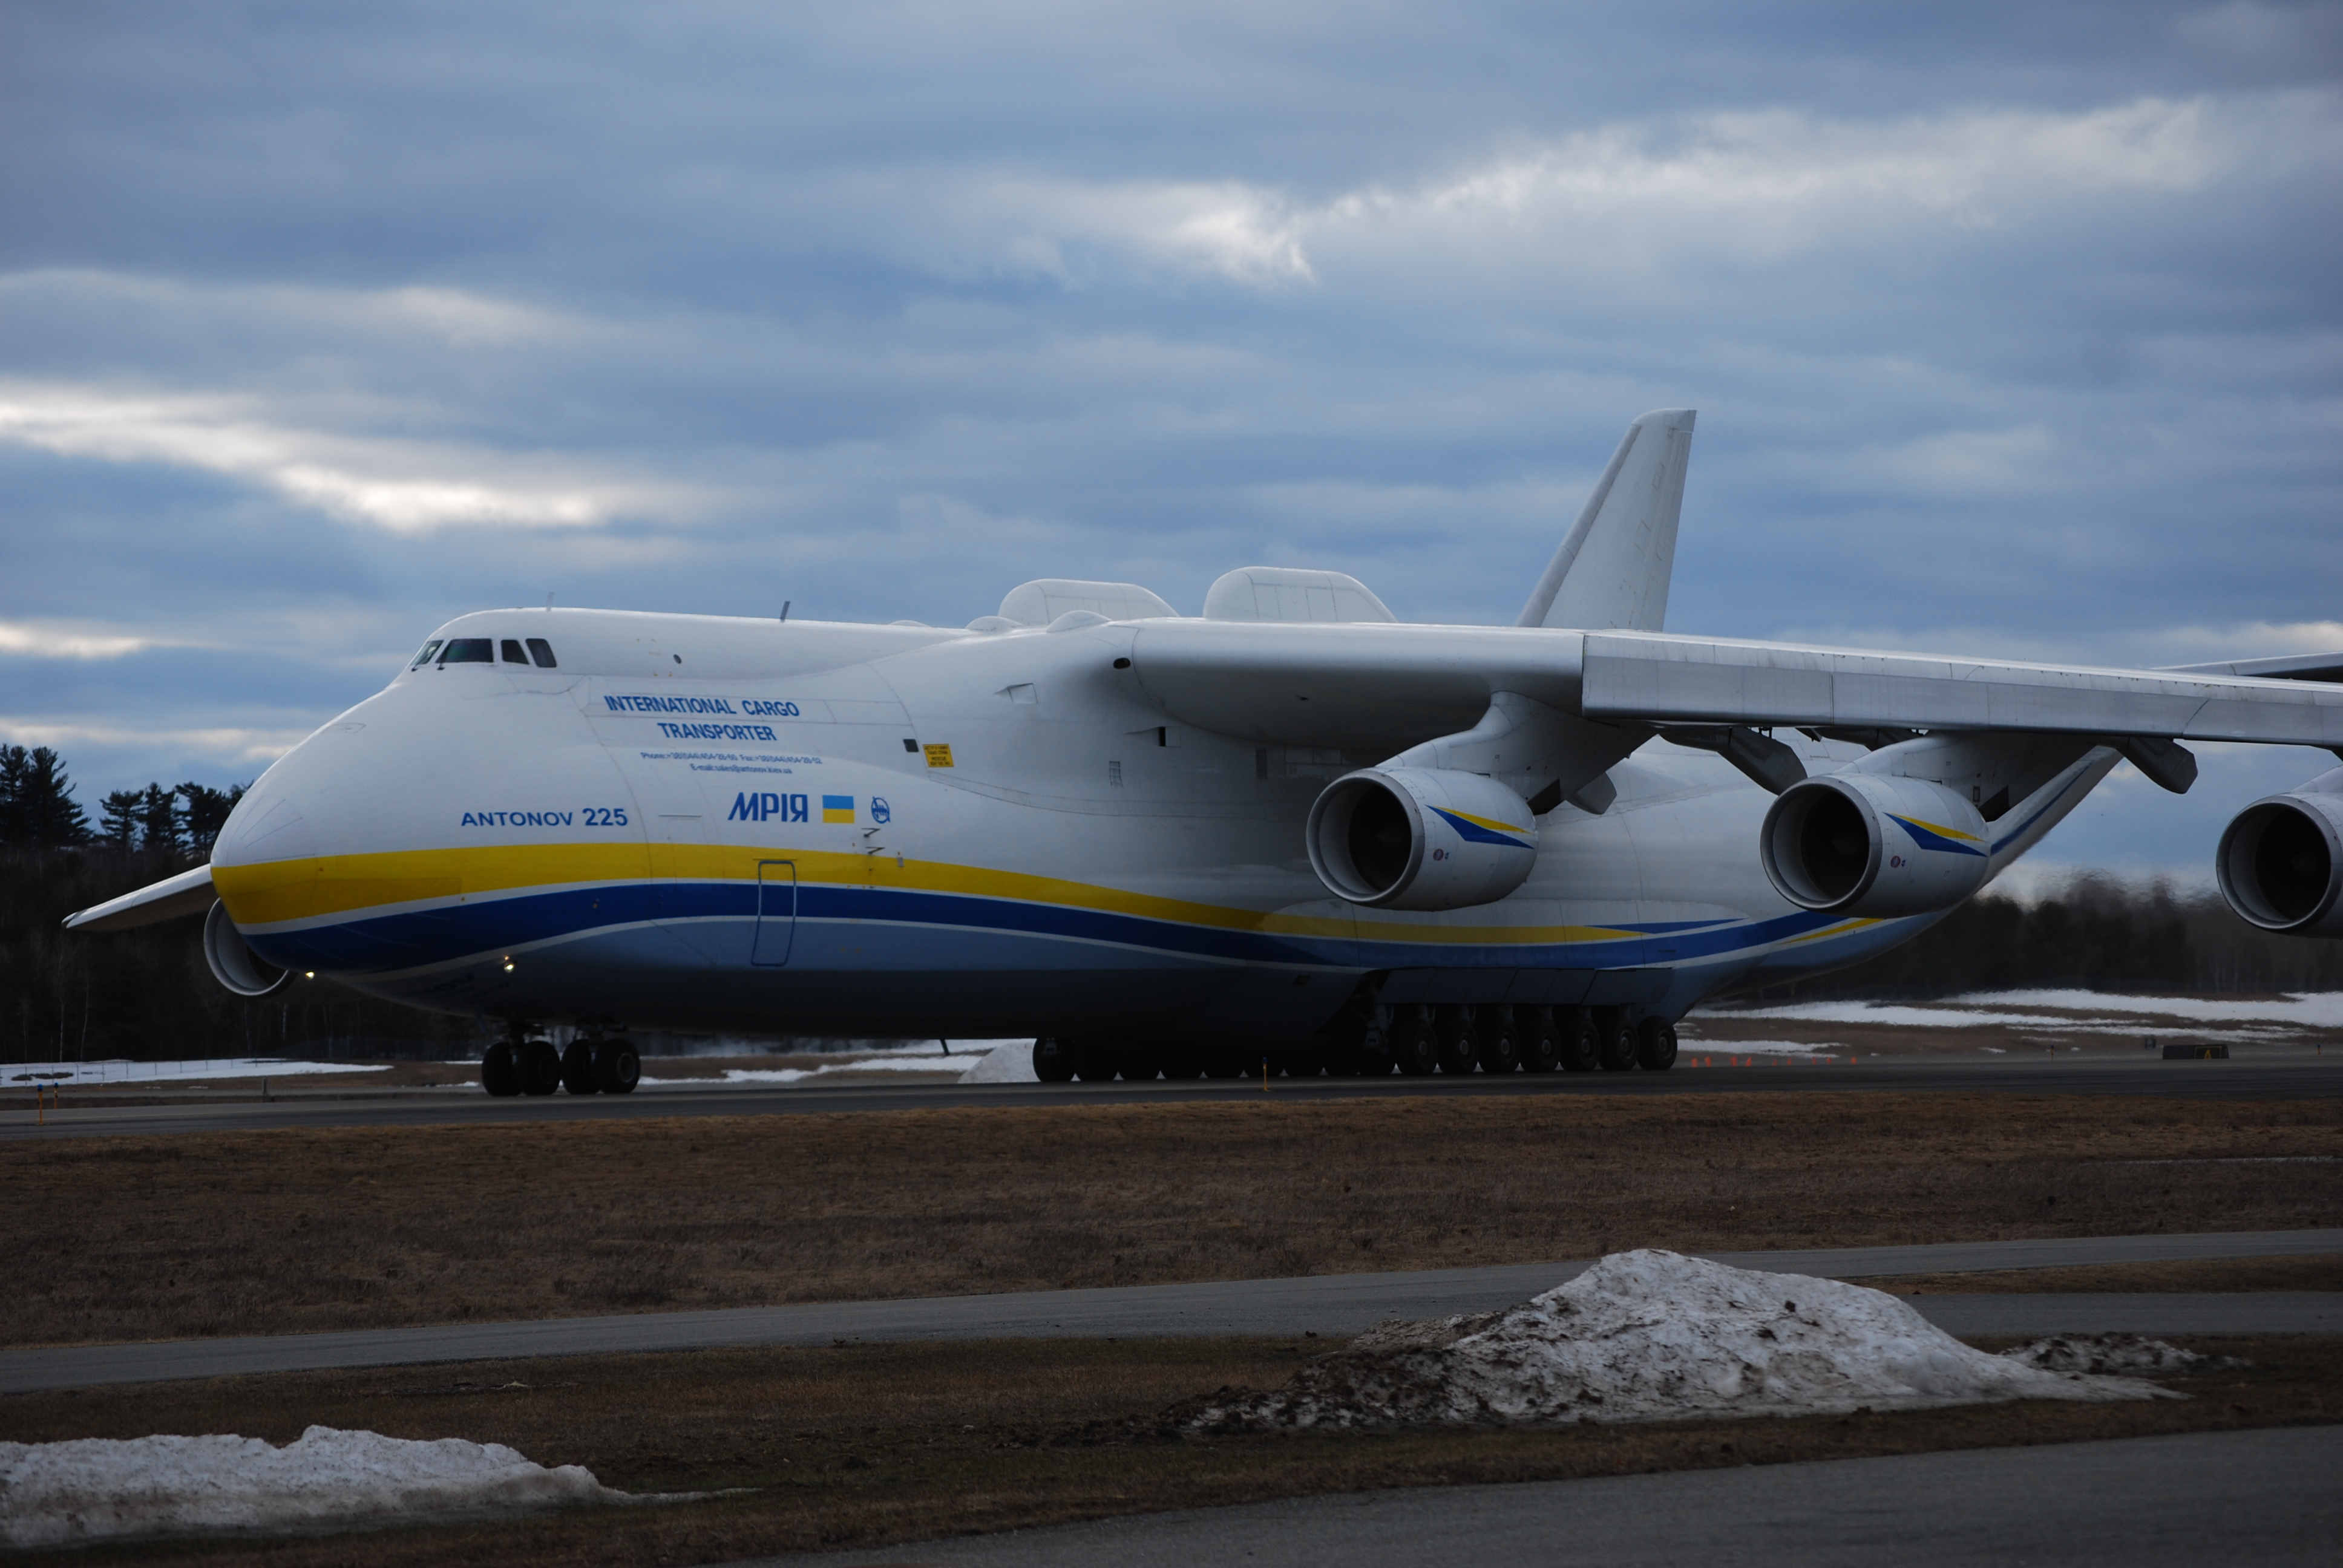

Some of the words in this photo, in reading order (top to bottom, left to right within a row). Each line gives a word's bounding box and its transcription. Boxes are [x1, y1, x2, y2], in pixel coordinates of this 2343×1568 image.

[604, 696, 738, 715] INTERNATIONAL
[742, 700, 801, 717] CARGO
[657, 723, 778, 742] TRANSPORTER
[462, 812, 574, 827] ANTONOV
[583, 808, 629, 827] 225
